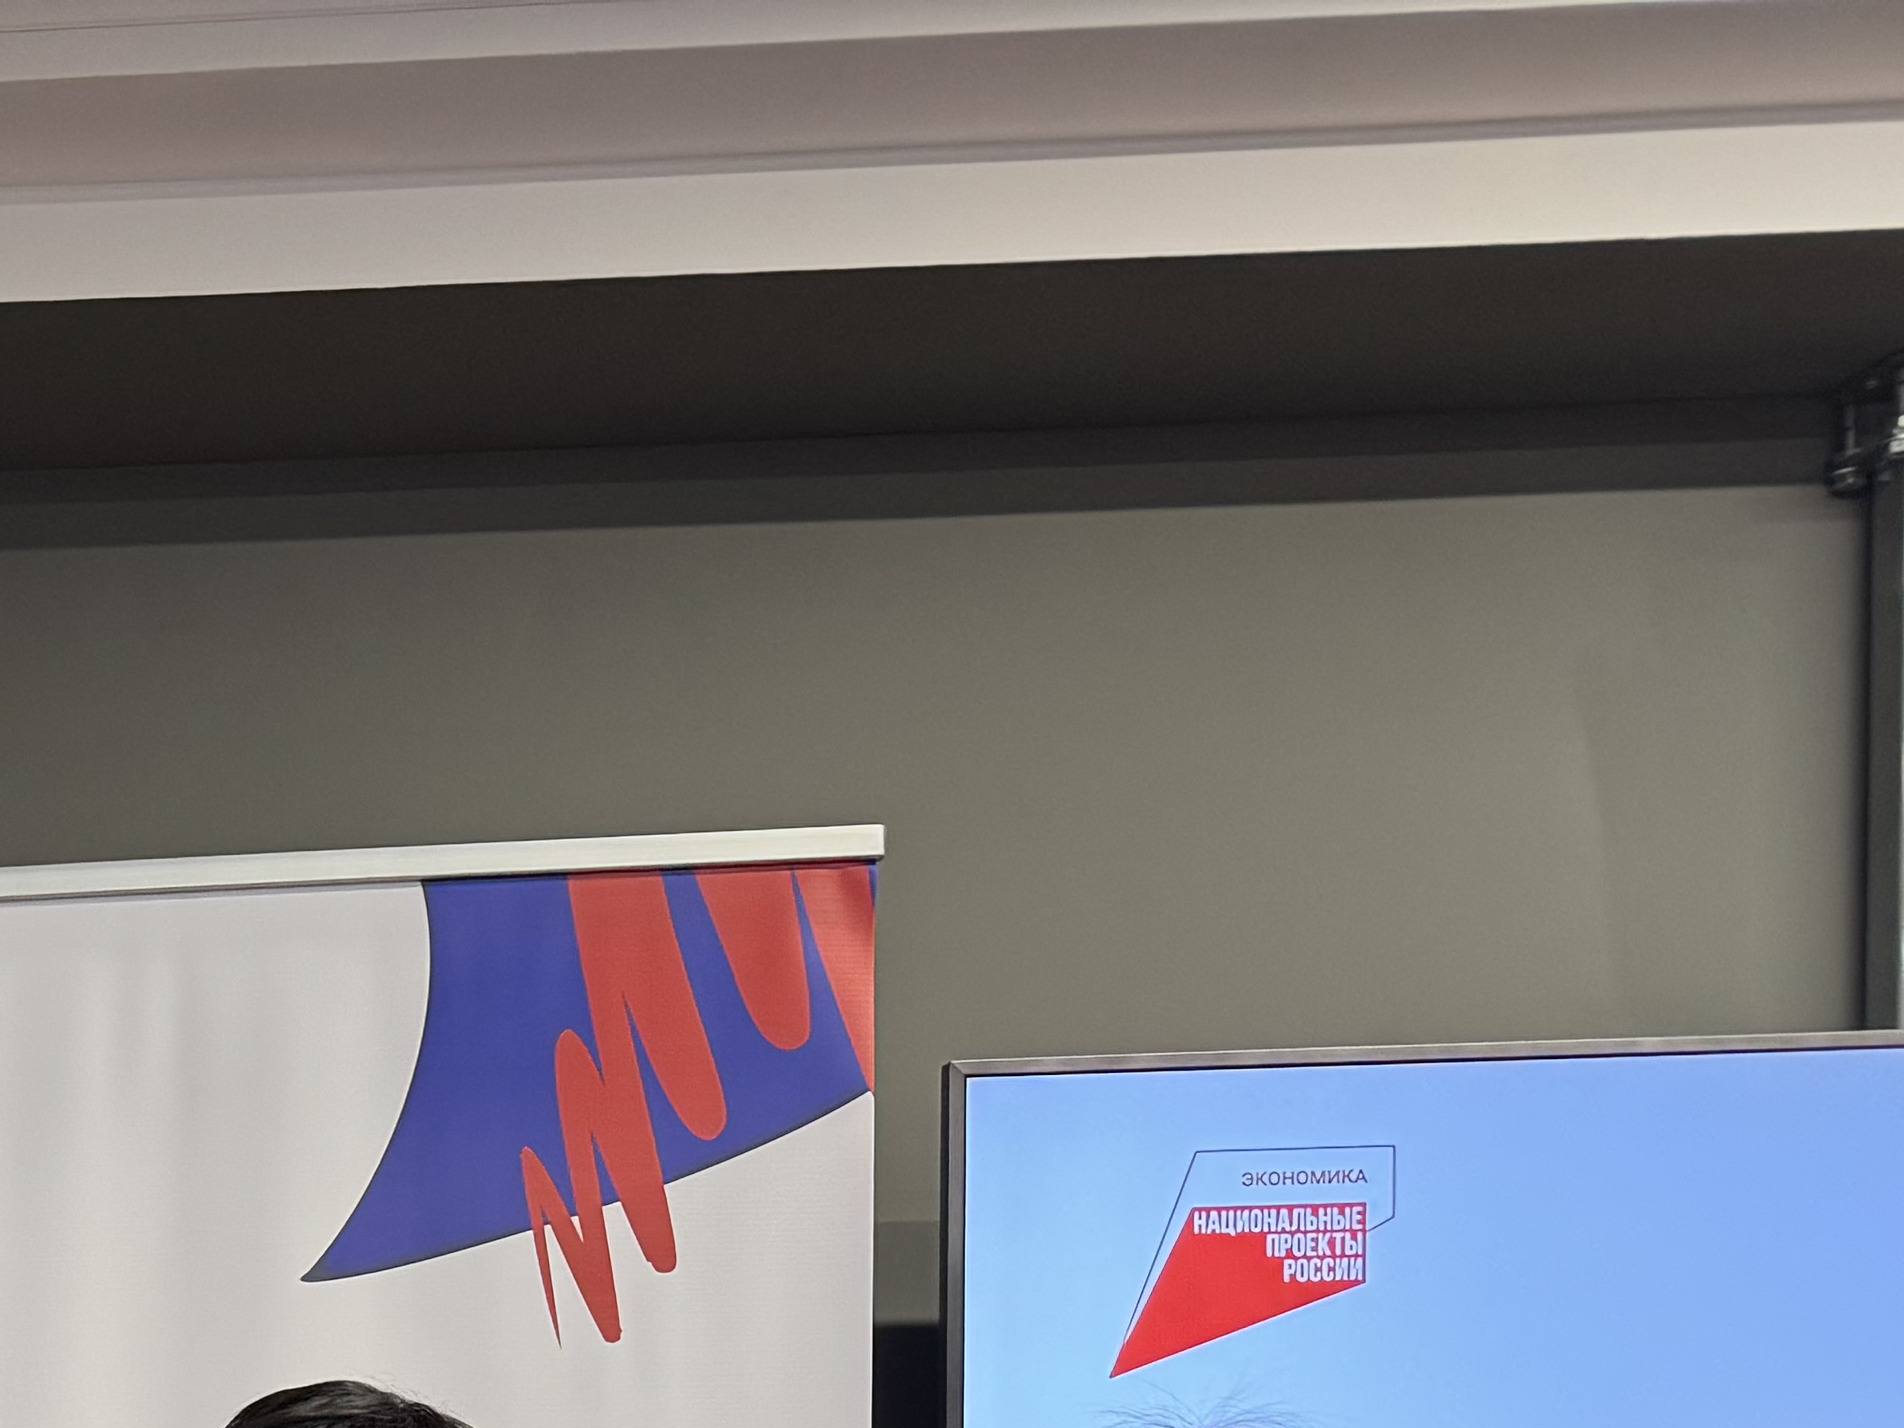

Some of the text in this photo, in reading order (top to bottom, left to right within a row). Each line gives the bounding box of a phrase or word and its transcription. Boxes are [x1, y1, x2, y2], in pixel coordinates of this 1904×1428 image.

[1241, 1168, 1368, 1186] ЭКОНОМИКА
[1193, 1206, 1363, 1236] НАЦИОНАЛЬНЫЕ
[1266, 1231, 1363, 1258] ПРОЕКТЫ
[1283, 1257, 1363, 1283] РОССИИ
